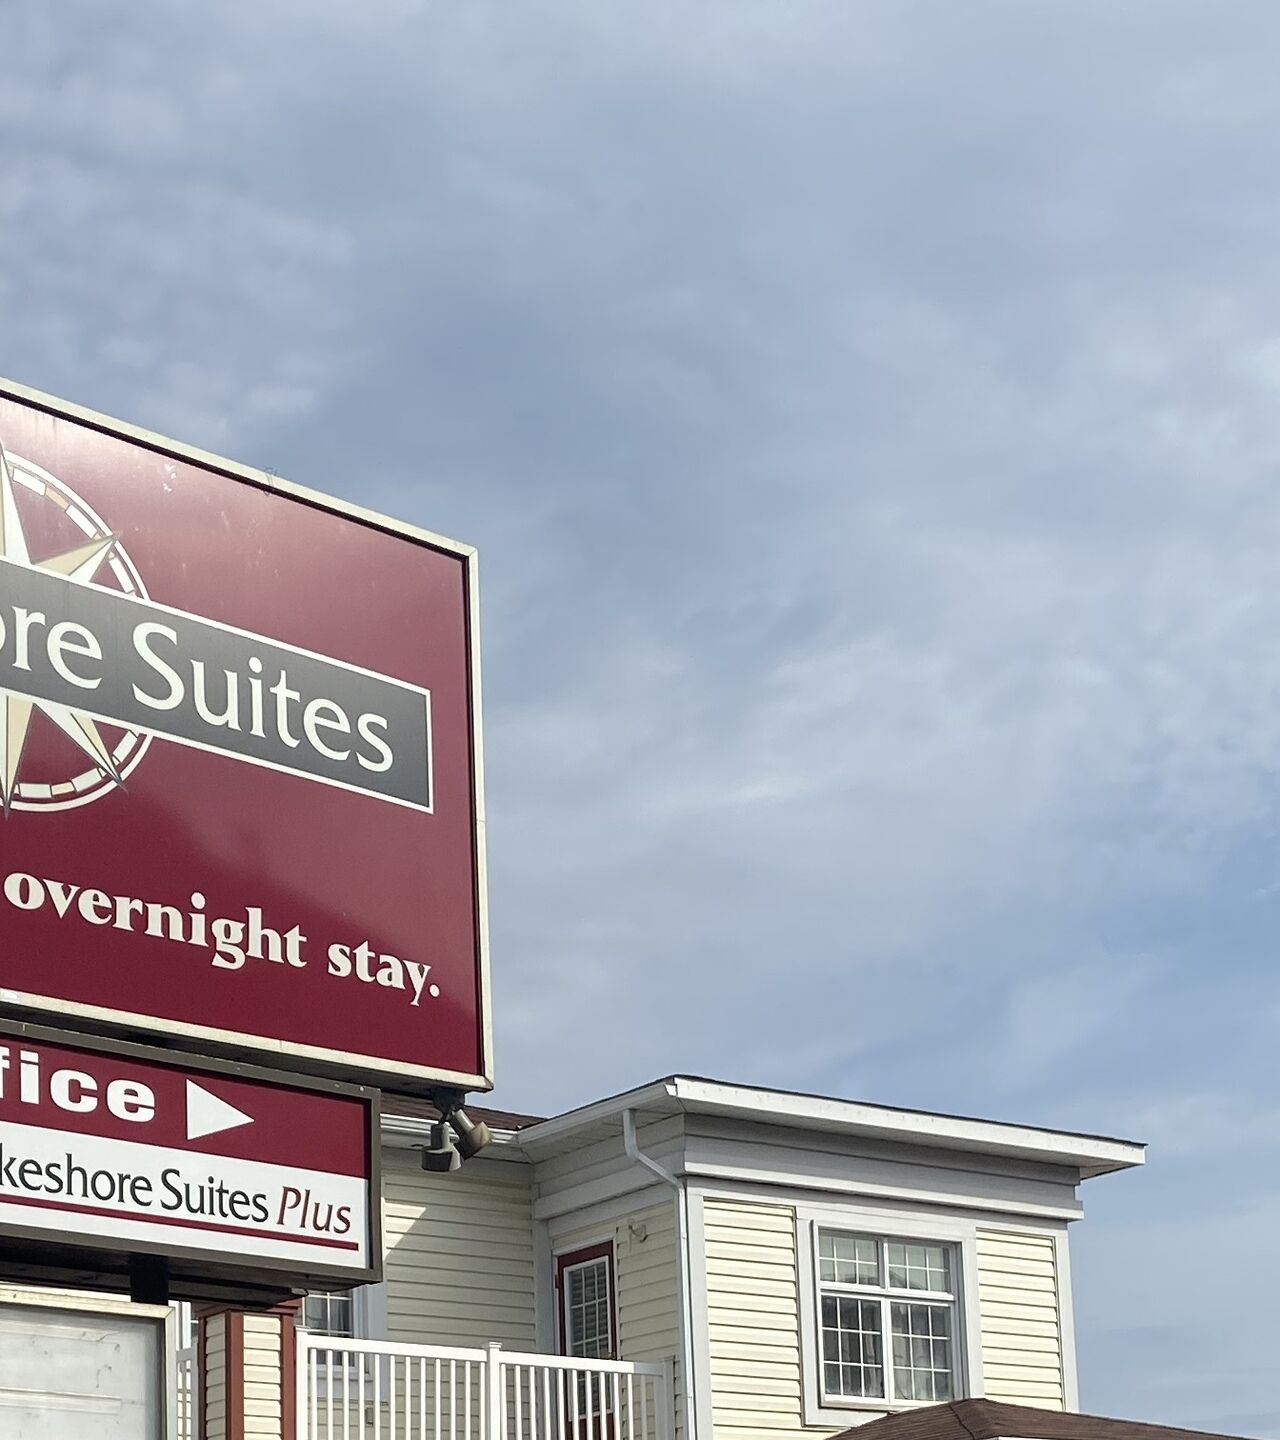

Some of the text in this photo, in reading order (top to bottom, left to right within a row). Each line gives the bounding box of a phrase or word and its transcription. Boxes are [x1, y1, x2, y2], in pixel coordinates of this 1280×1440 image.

[130, 620, 394, 774] Suites
[3, 872, 308, 971] overnight
[326, 941, 441, 1008] stay.
[160, 1167, 269, 1223] Suites
[275, 1186, 353, 1237] Plus
